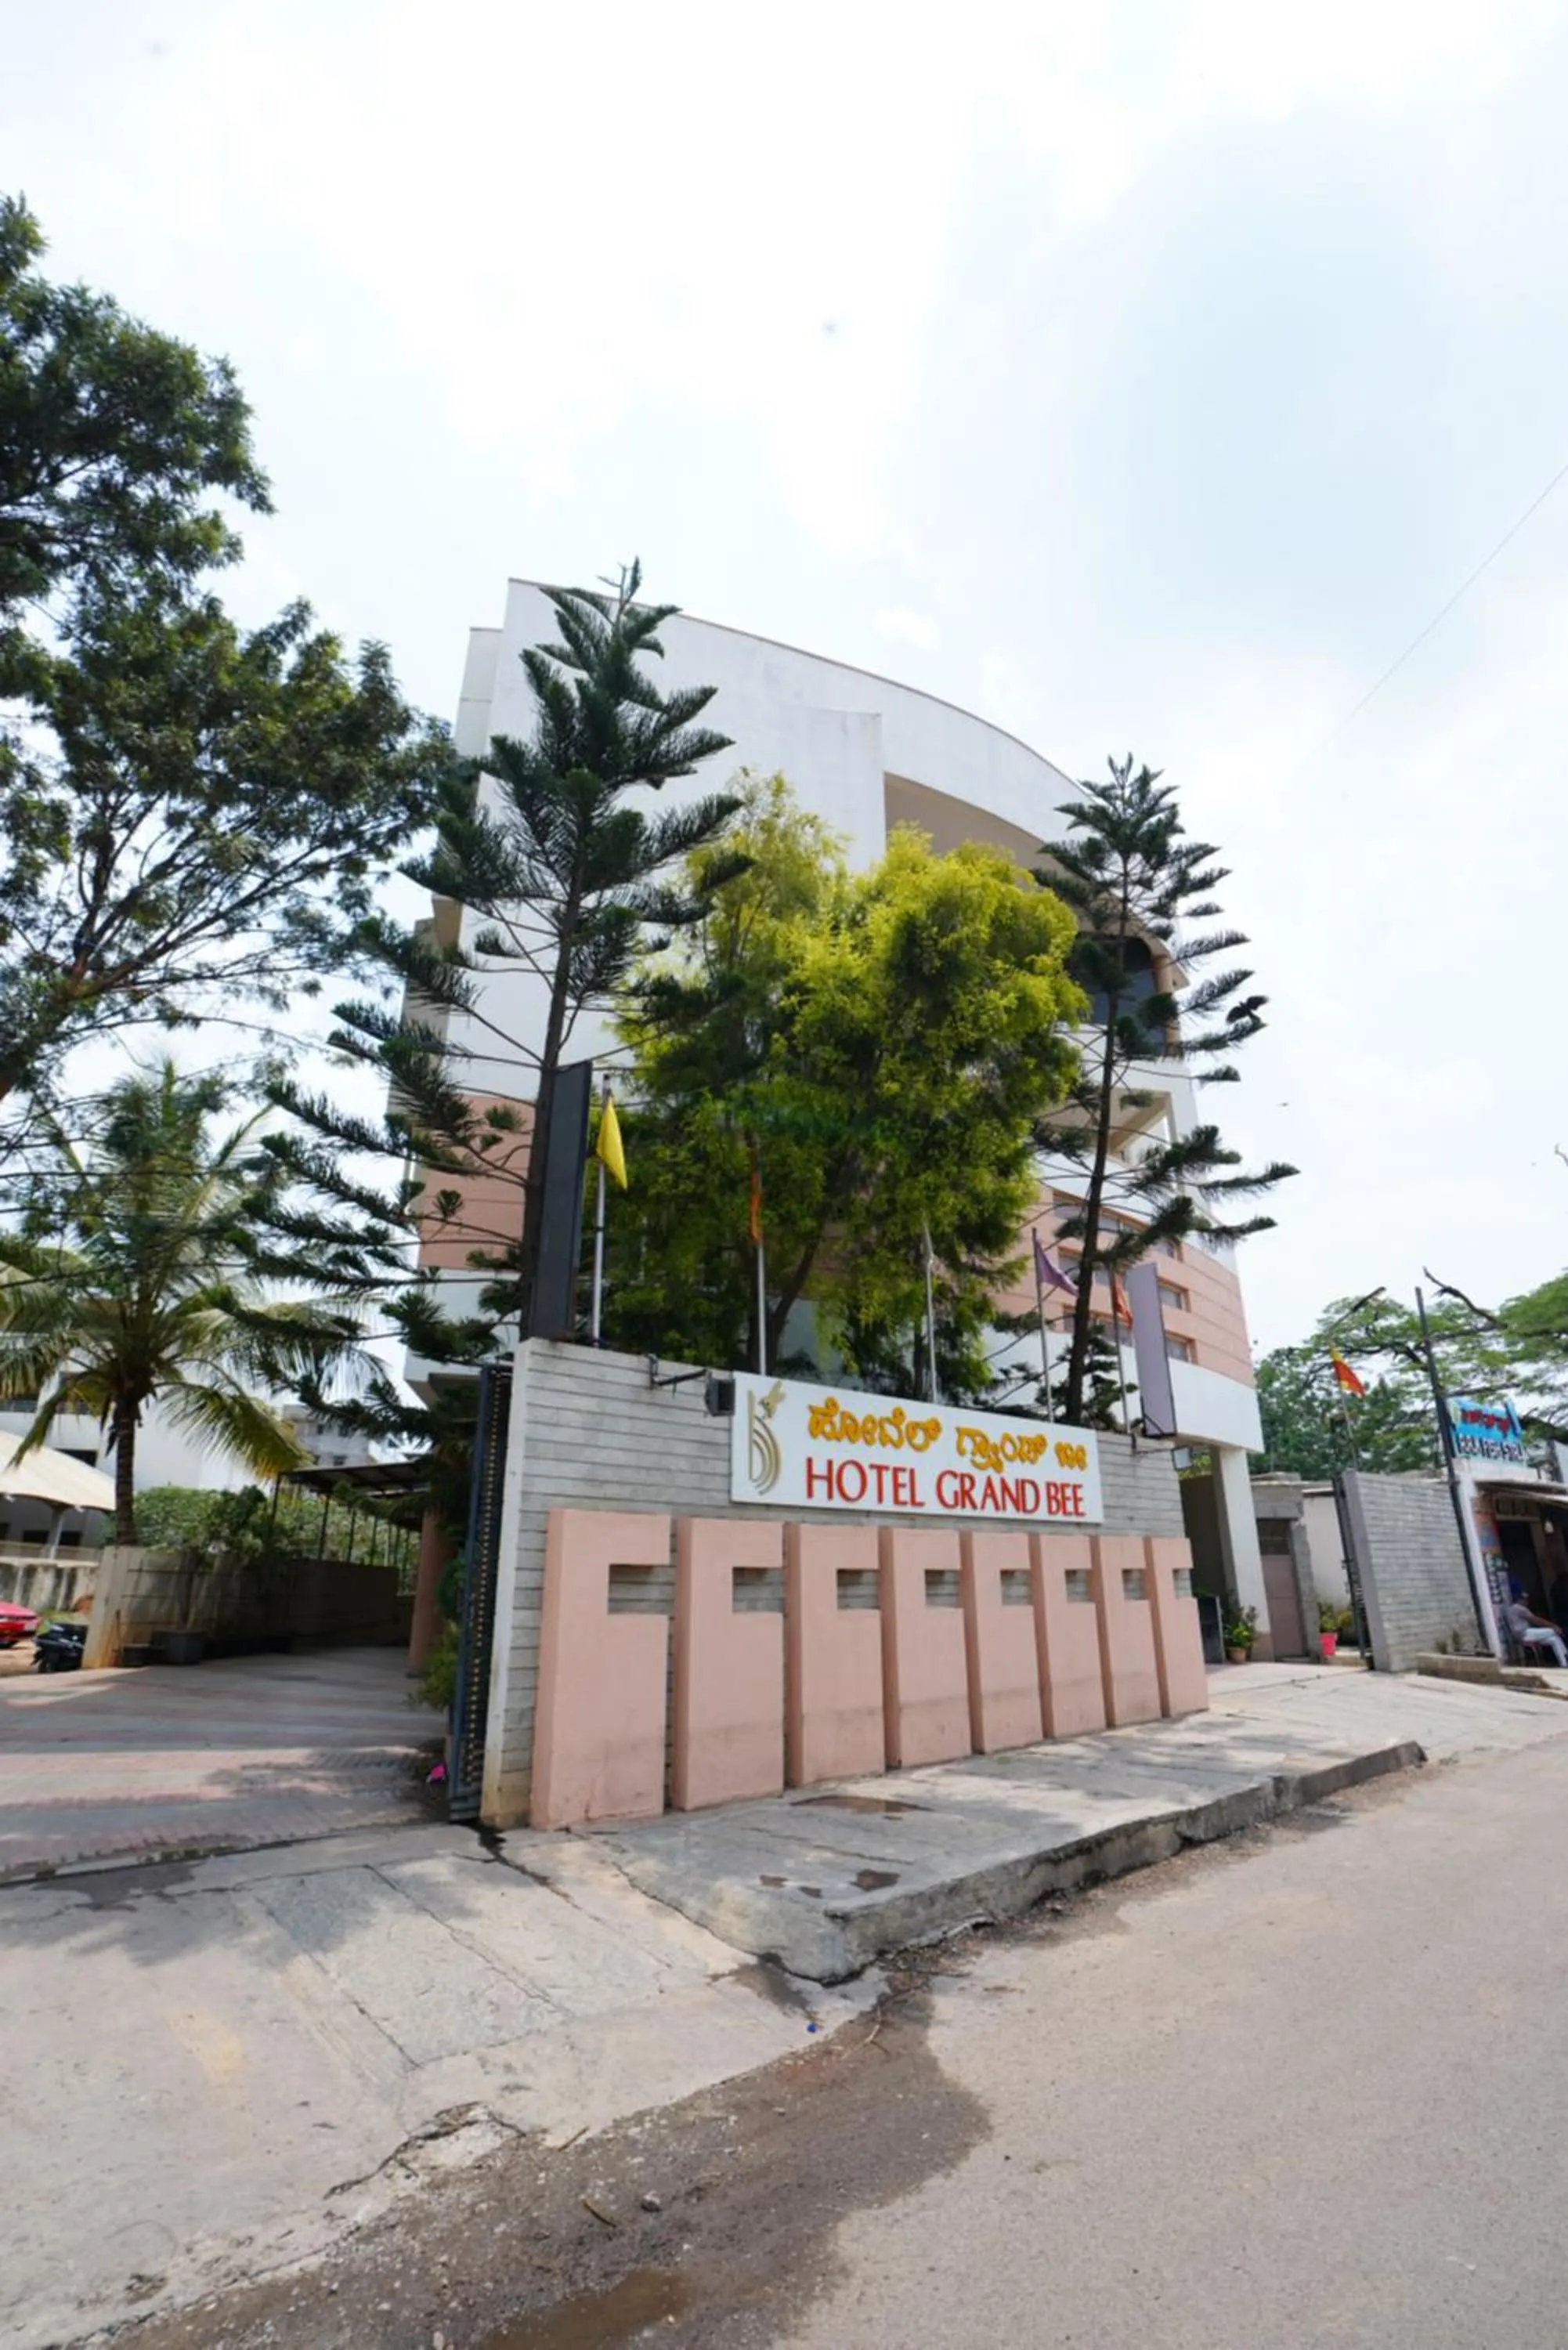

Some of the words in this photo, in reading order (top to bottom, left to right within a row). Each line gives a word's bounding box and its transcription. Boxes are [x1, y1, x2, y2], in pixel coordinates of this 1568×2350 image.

[806, 1457, 925, 1507] HOTEL
[936, 1470, 1040, 1514] GRAND
[1046, 1481, 1086, 1517] BEE
